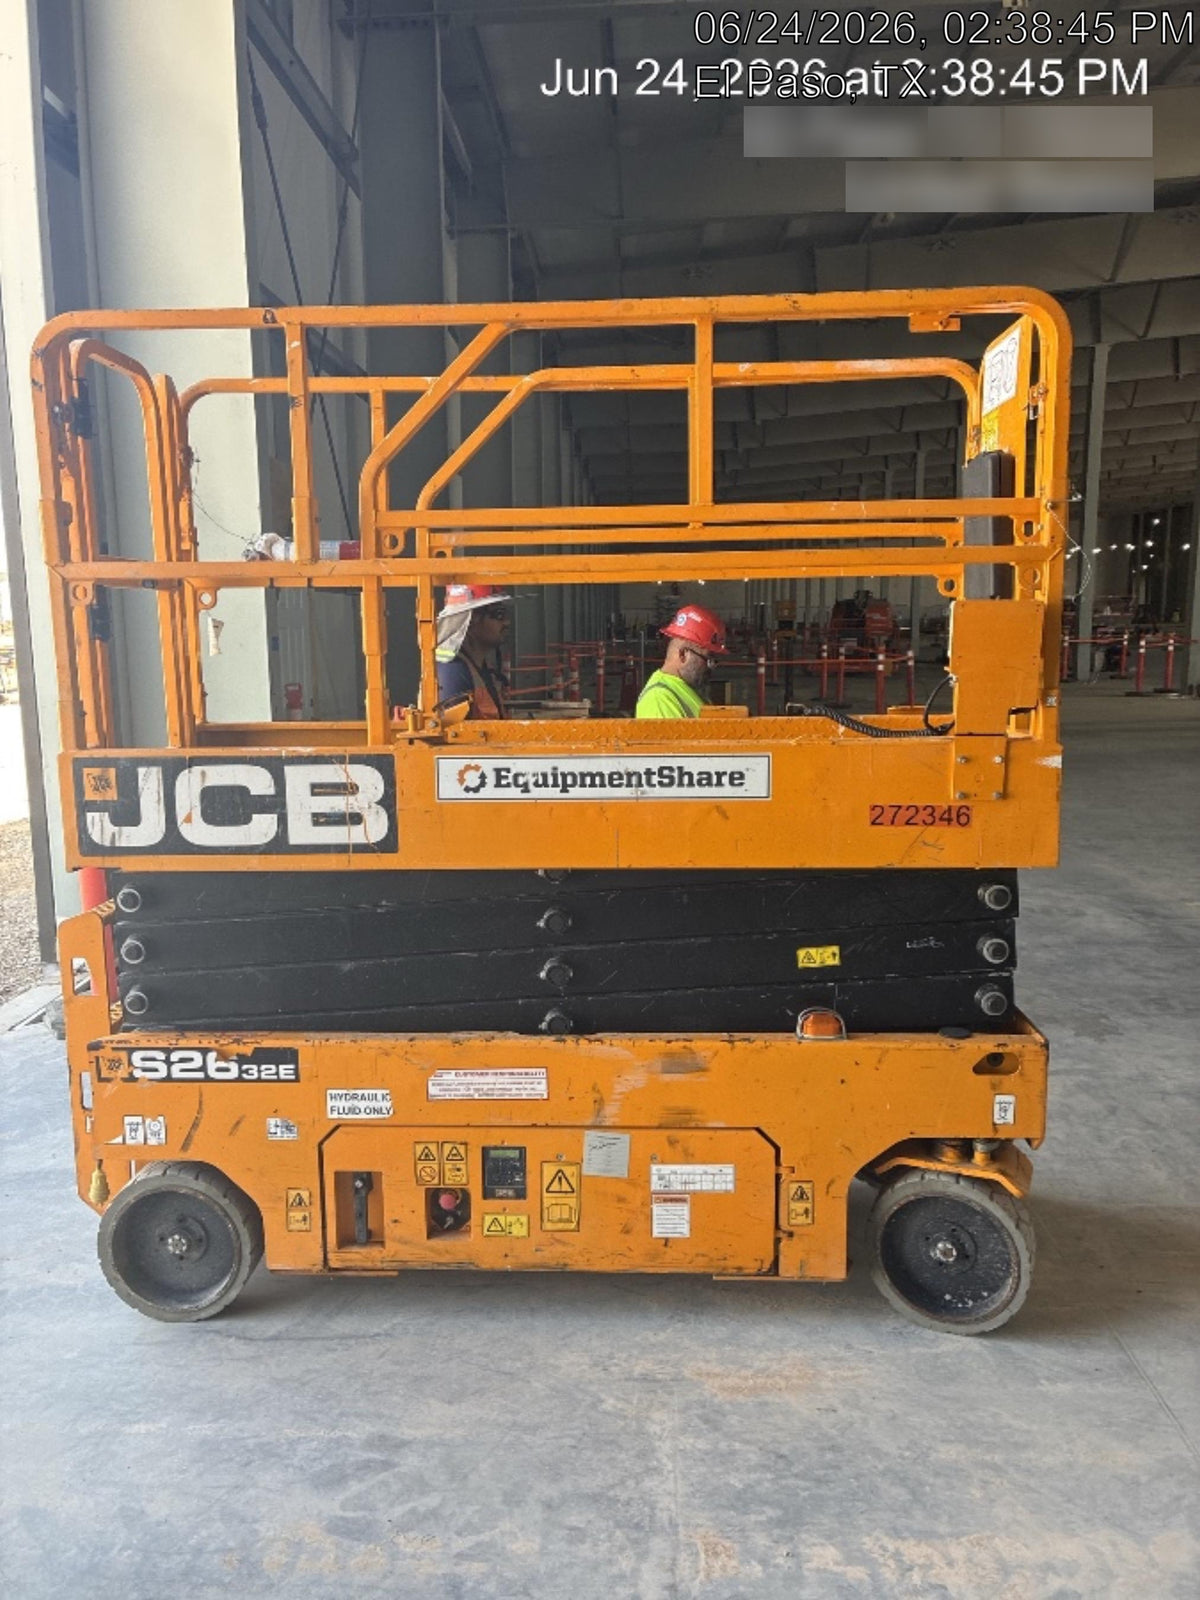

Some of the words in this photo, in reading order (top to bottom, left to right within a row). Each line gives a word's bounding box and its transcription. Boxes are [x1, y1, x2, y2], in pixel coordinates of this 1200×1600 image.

[493, 765, 747, 793] EquipmentShare
[86, 764, 389, 847] JCB
[870, 804, 971, 827] 272346
[131, 1049, 240, 1080] S26
[241, 1063, 297, 1080] 32E
[330, 1105, 361, 1115] FLUID
[363, 1105, 392, 1115] ONLY
